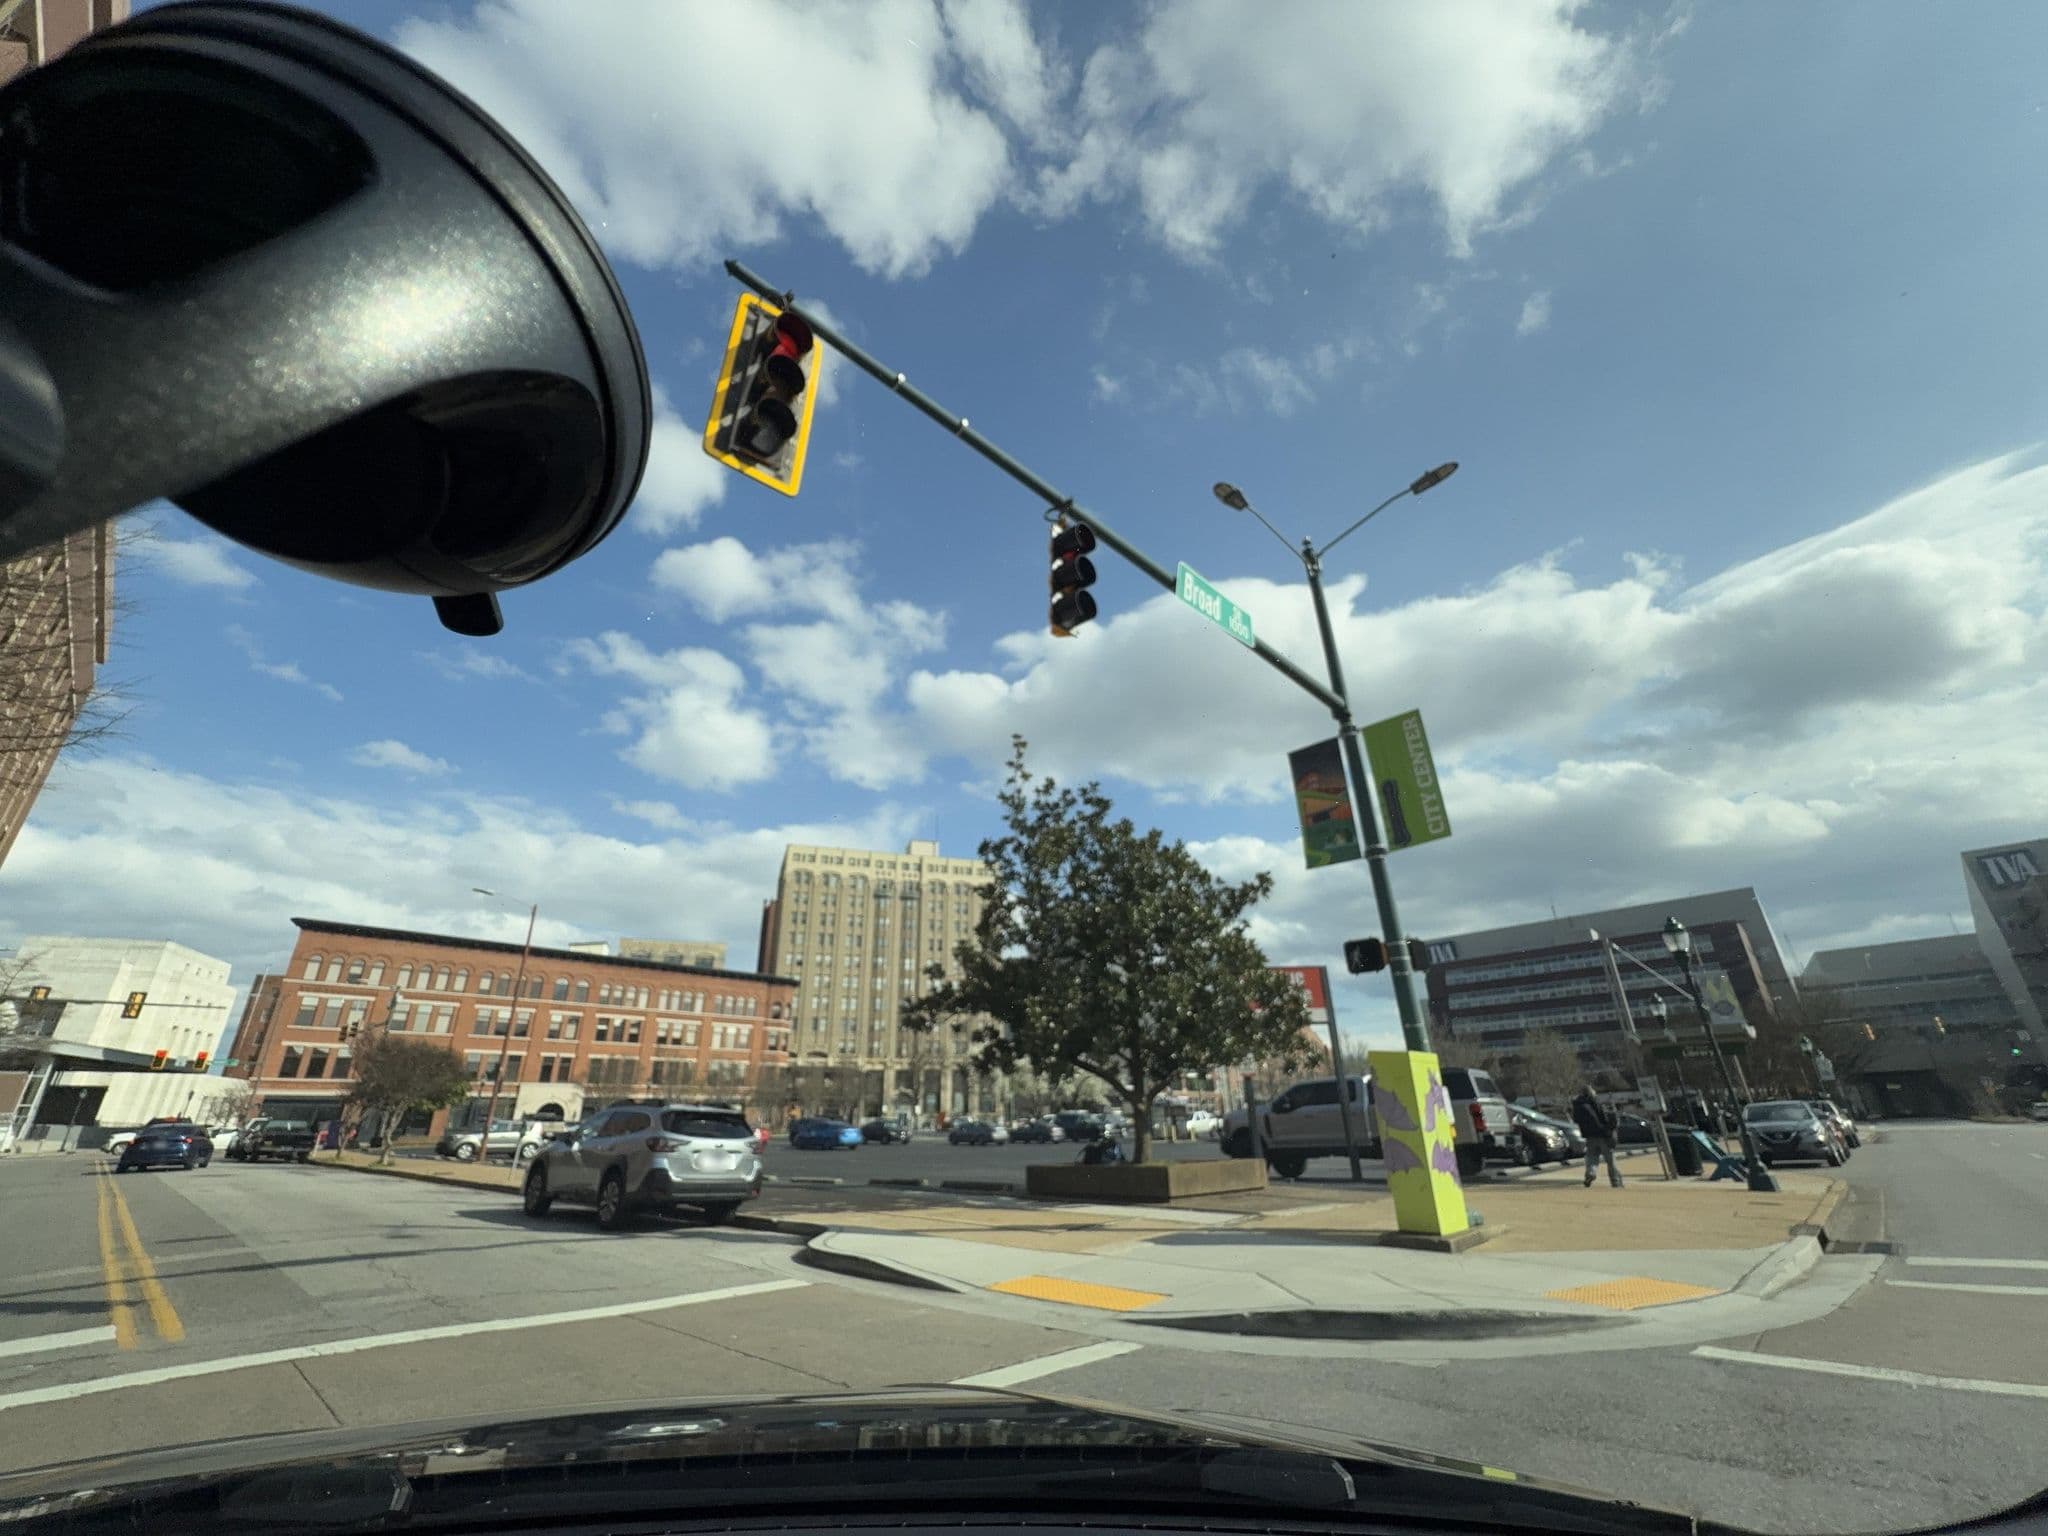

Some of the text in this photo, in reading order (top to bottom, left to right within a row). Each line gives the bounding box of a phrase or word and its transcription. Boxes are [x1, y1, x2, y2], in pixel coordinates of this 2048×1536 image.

[1183, 571, 1221, 622] Broad
[1402, 716, 1445, 835] CITY CENTER
